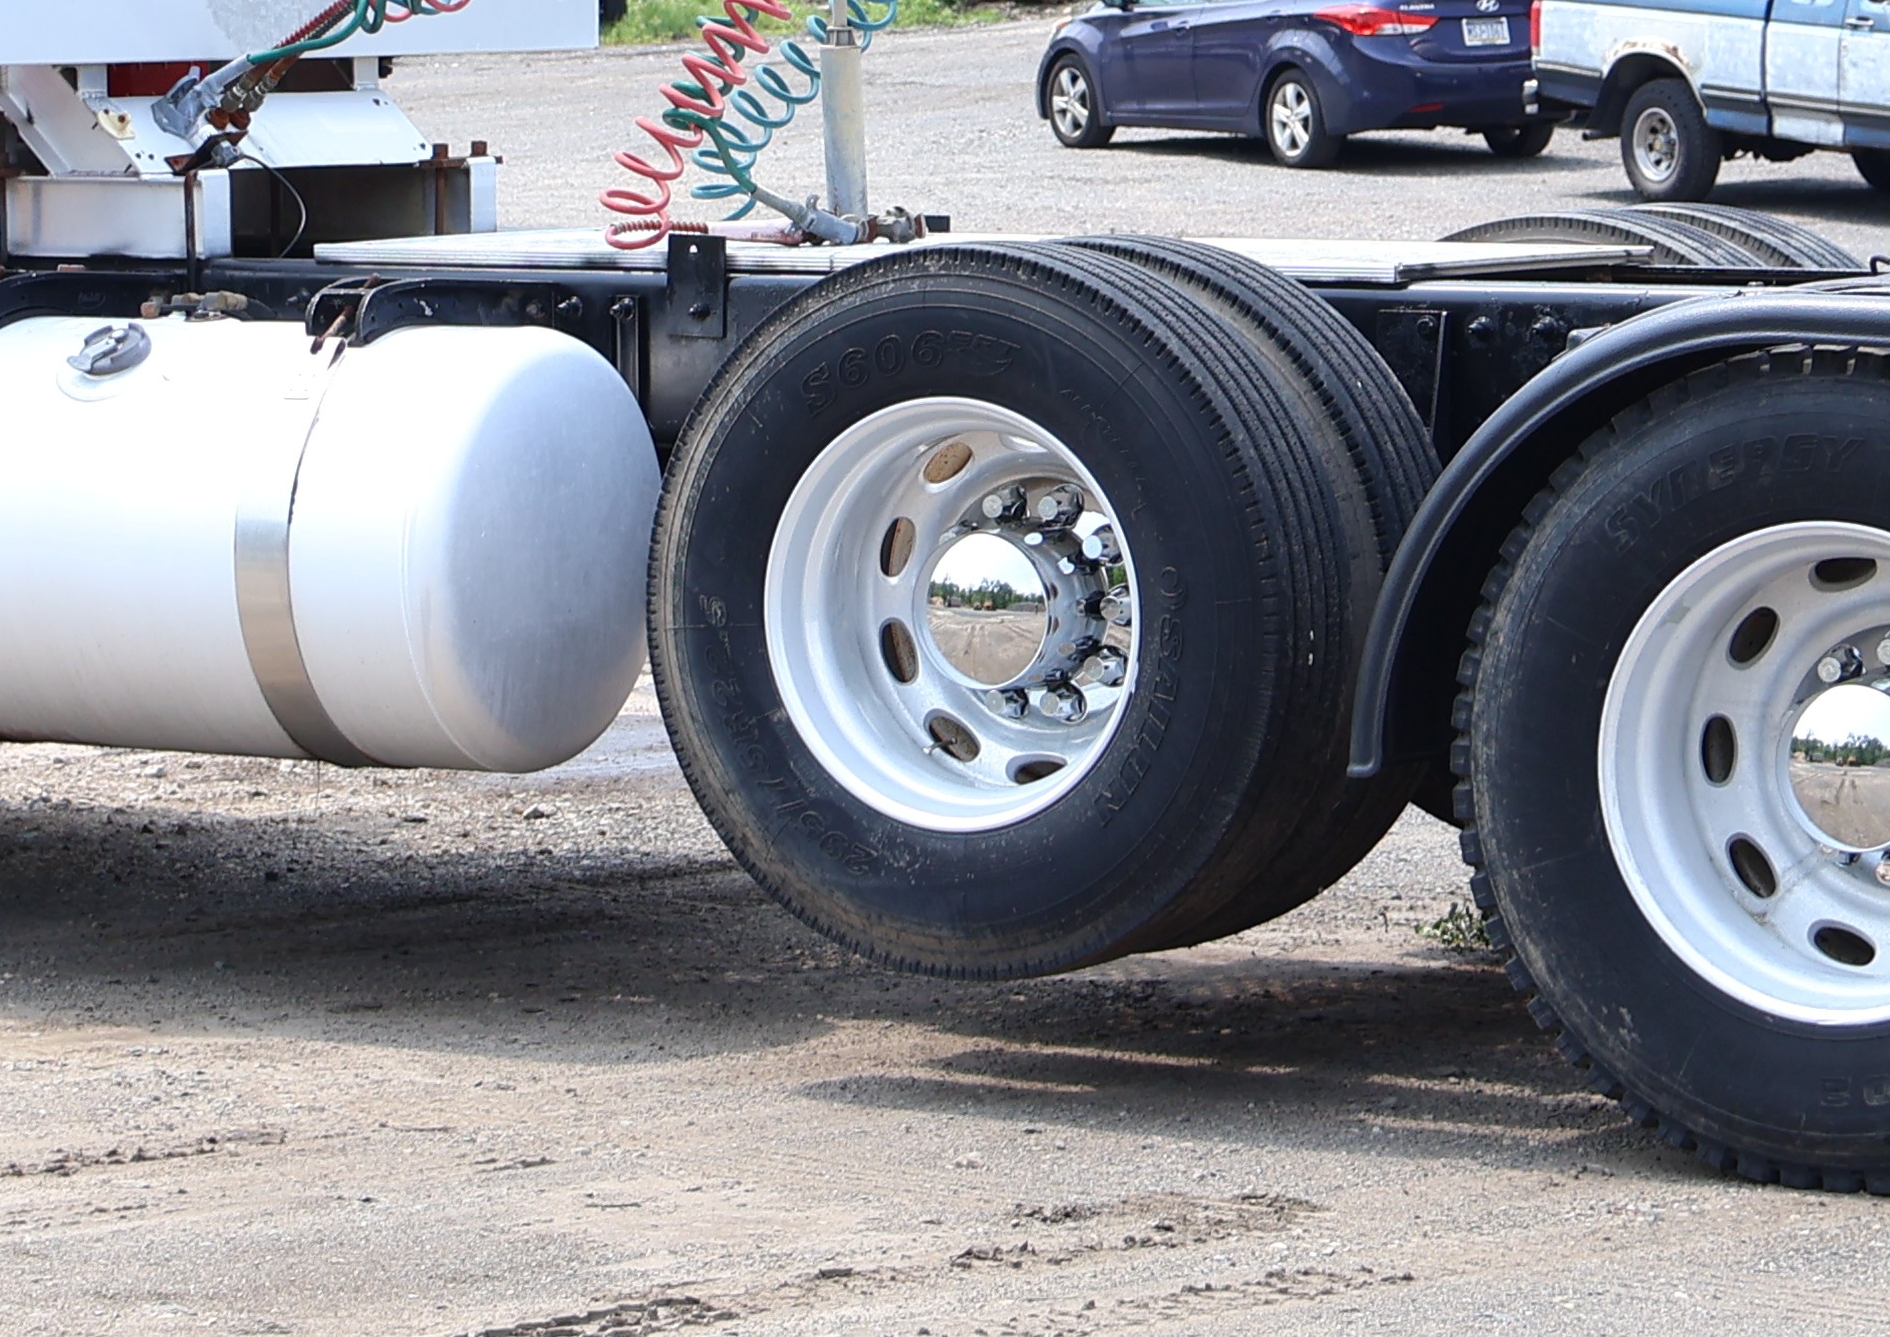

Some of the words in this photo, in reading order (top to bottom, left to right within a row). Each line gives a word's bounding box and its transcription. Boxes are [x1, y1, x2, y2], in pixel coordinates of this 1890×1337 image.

[800, 328, 947, 417] S606
[1605, 431, 1866, 556] SYNERGY
[1093, 613, 1185, 830] SAILUN
